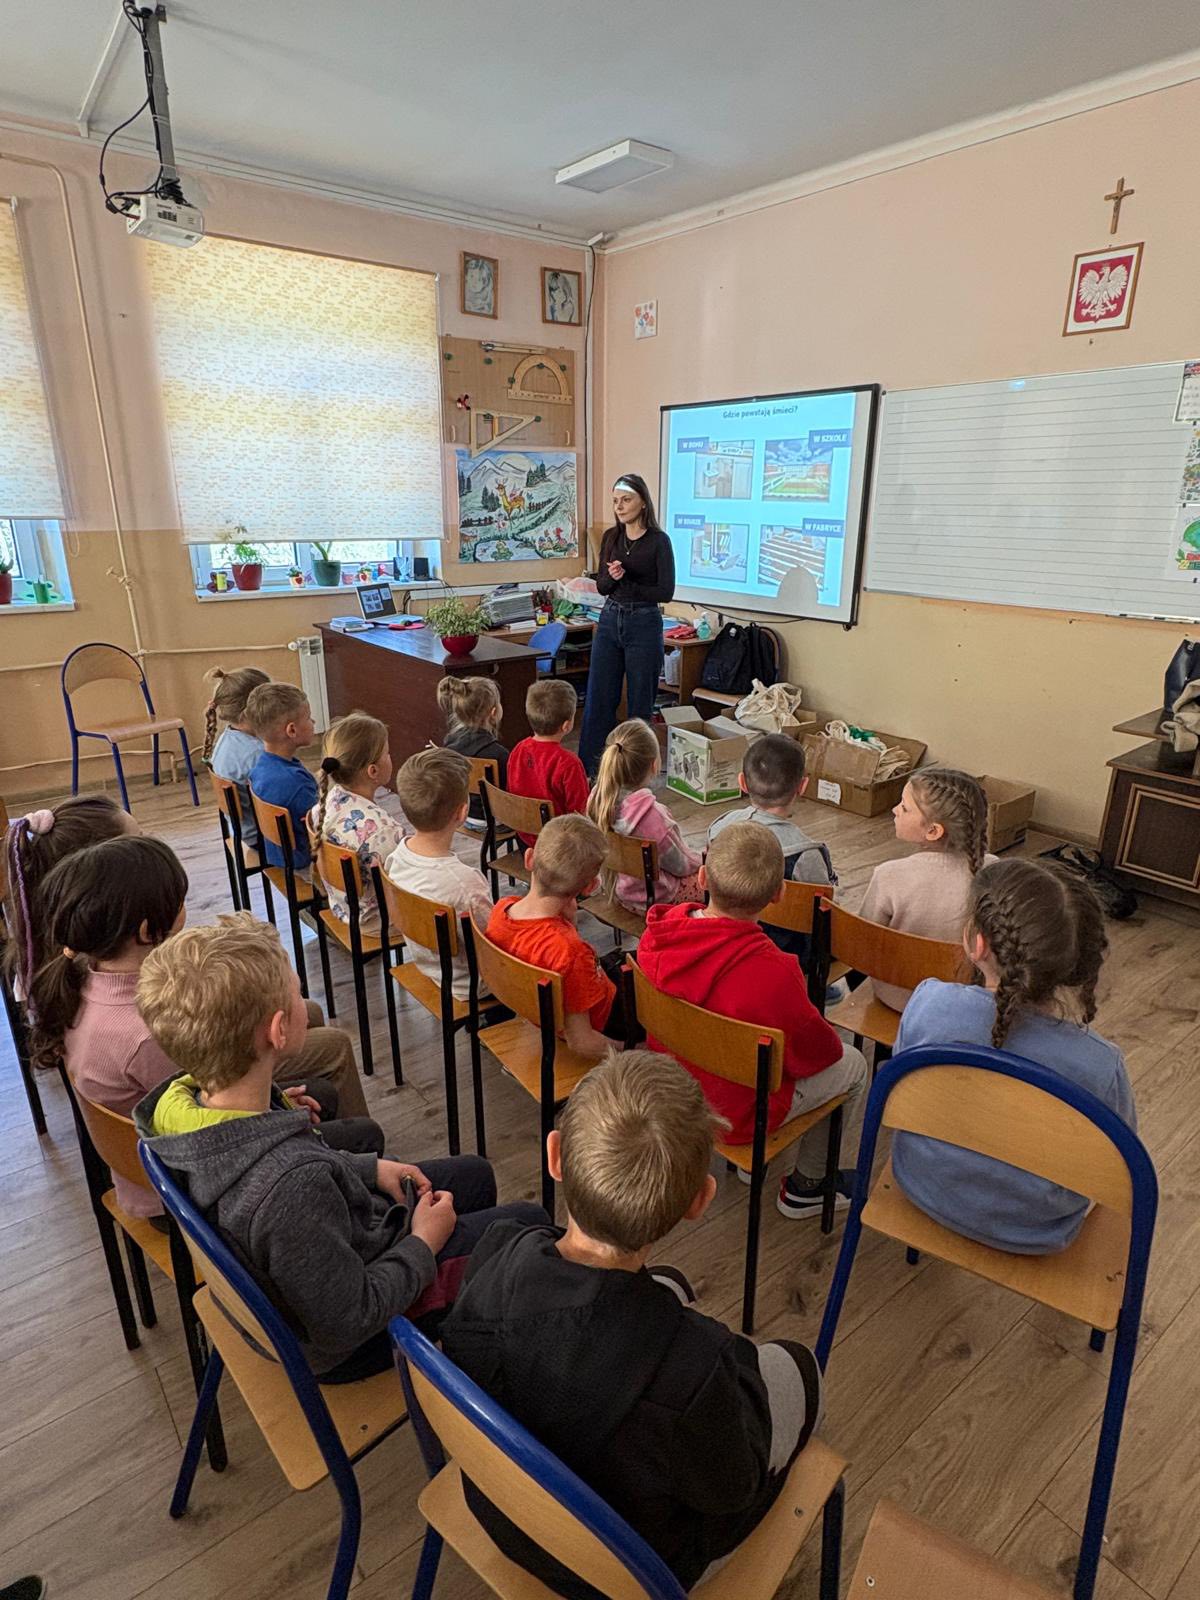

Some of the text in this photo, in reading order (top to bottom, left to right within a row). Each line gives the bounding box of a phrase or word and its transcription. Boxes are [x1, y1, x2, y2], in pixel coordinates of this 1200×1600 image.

[723, 405, 798, 419] Gdzie powstają śmieci?
[821, 433, 848, 442] SZKOLE
[812, 523, 842, 532] FABRYCE
